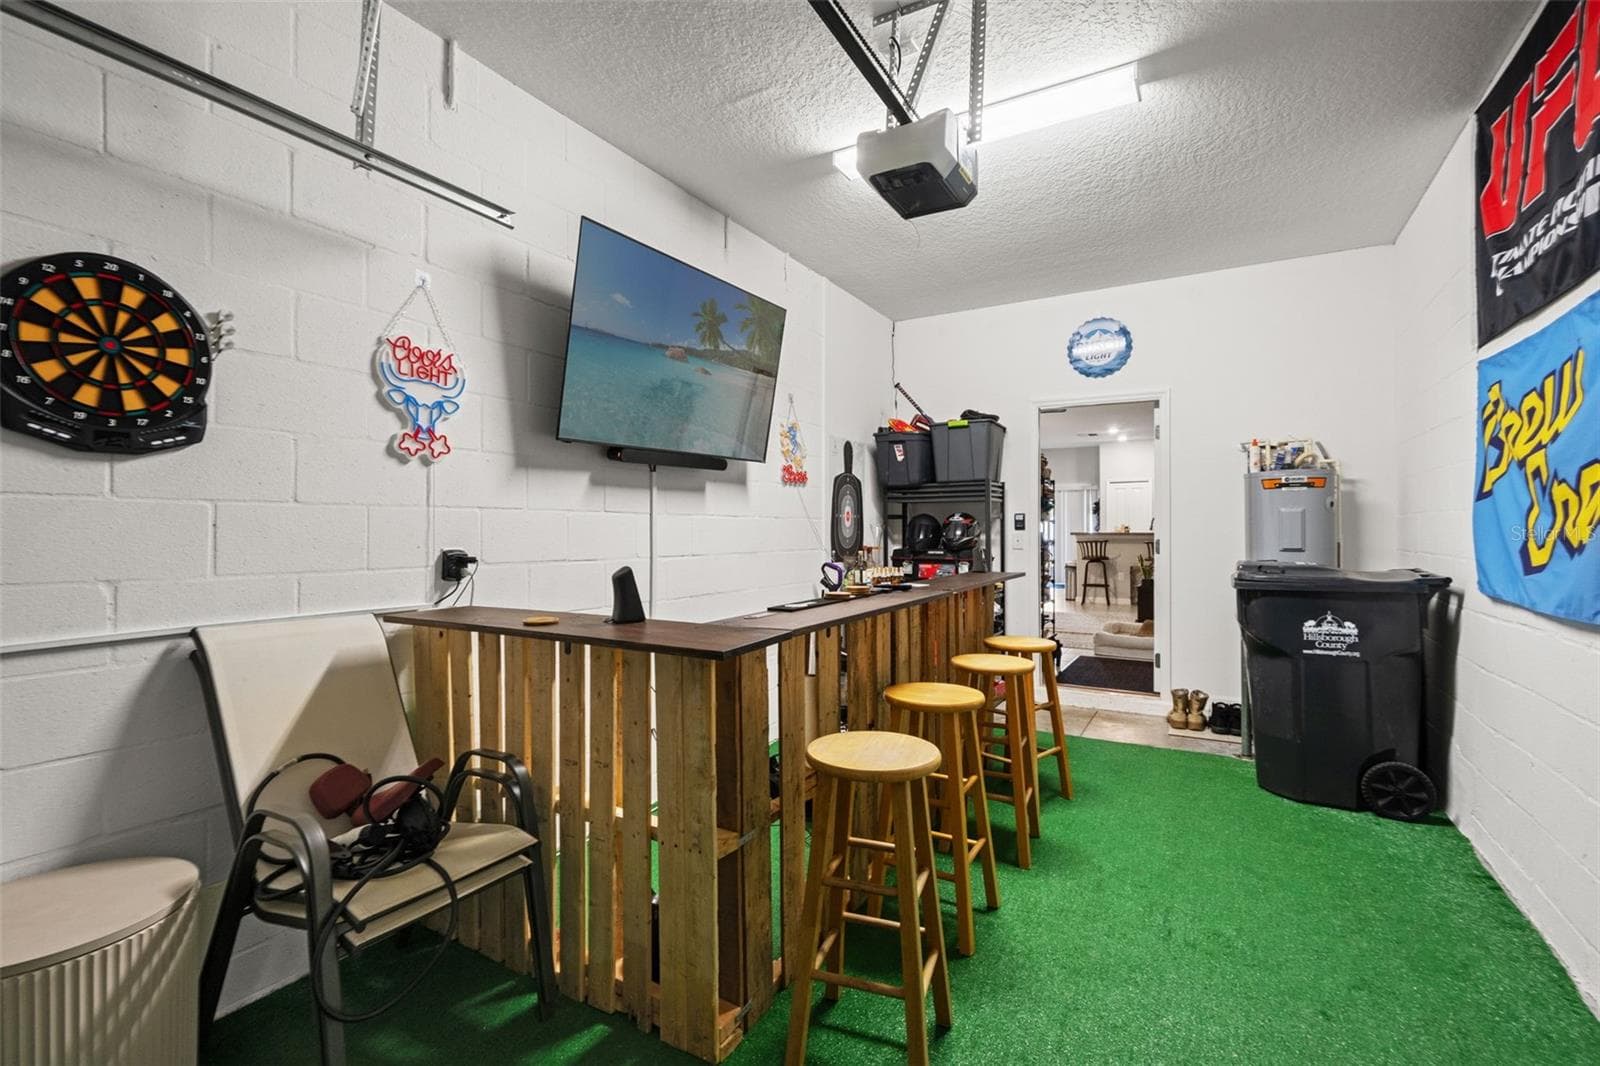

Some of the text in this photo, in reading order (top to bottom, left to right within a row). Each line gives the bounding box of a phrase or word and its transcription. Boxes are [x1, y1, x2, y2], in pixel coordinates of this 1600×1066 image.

[41, 263, 56, 272] 12
[74, 259, 84, 268] 5
[103, 262, 120, 272] 20
[183, 310, 192, 318] 4
[195, 333, 205, 341] 13
[386, 336, 457, 374] Coors
[201, 356, 209, 364] 6
[398, 359, 452, 386] LIGHT
[16, 375, 31, 384] 16
[196, 377, 206, 385] 10
[45, 397, 55, 405] 7
[183, 396, 194, 404] 15
[73, 411, 88, 420] 19
[108, 418, 117, 427] 3
[137, 418, 149, 426] 17
[1476, 346, 1584, 502] Brew
[1303, 632, 1359, 644] Hillsborough
[1315, 640, 1348, 650] County
